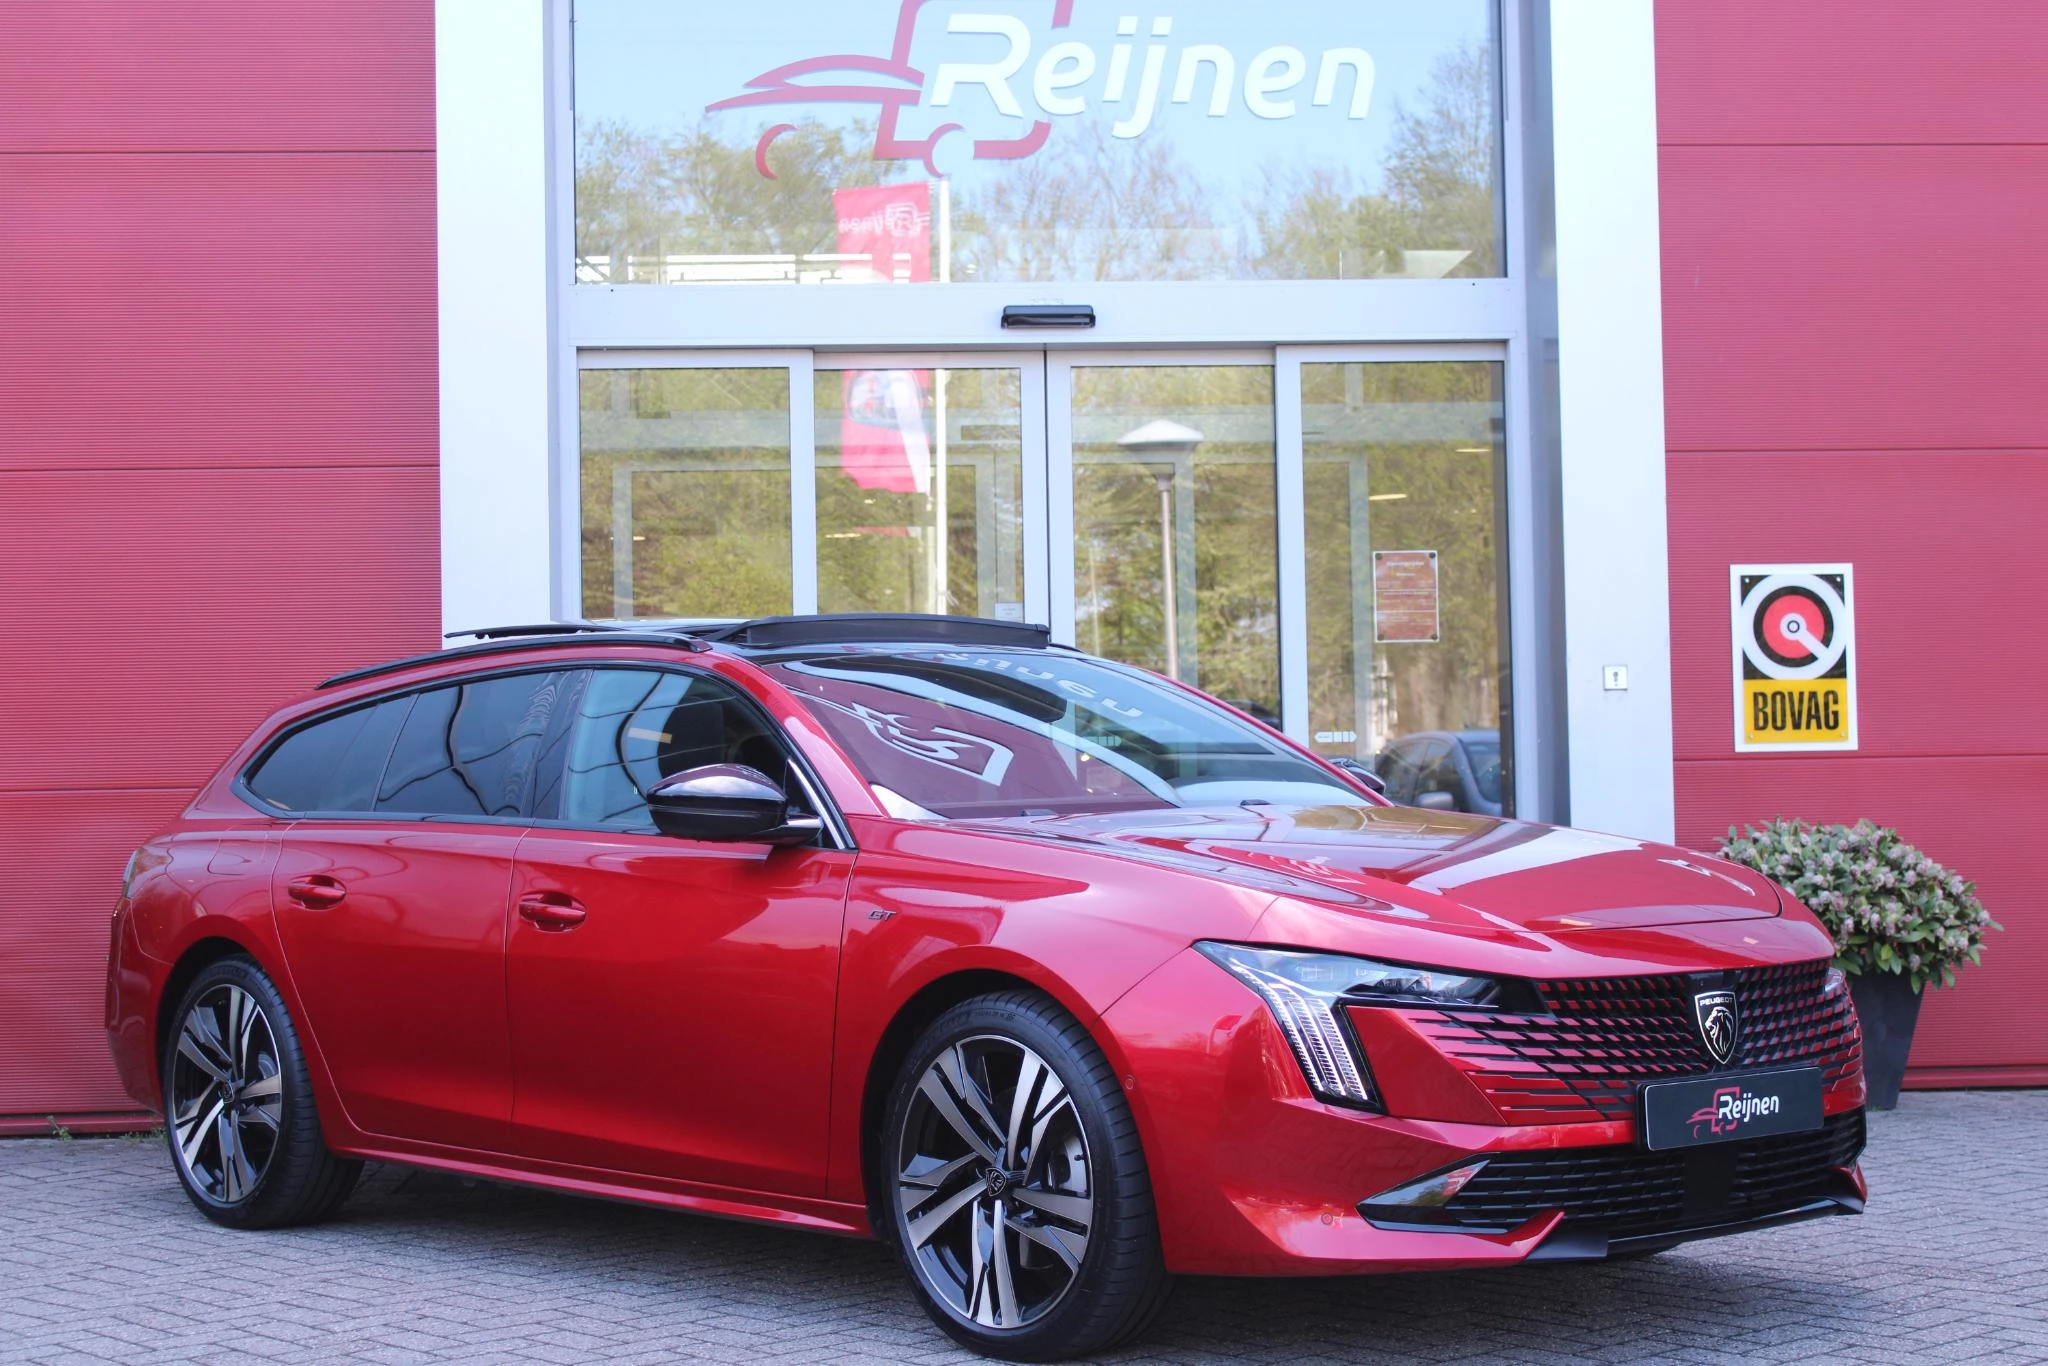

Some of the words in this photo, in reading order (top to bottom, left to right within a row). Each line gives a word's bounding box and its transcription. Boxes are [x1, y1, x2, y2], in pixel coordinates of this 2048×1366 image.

[930, 14, 1375, 139] Reijnen
[1753, 690, 1839, 731] BOVAG
[868, 909, 896, 922] GT
[1700, 997, 1733, 1006] PEUGEOT
[1718, 1093, 1779, 1122] Reijnen
